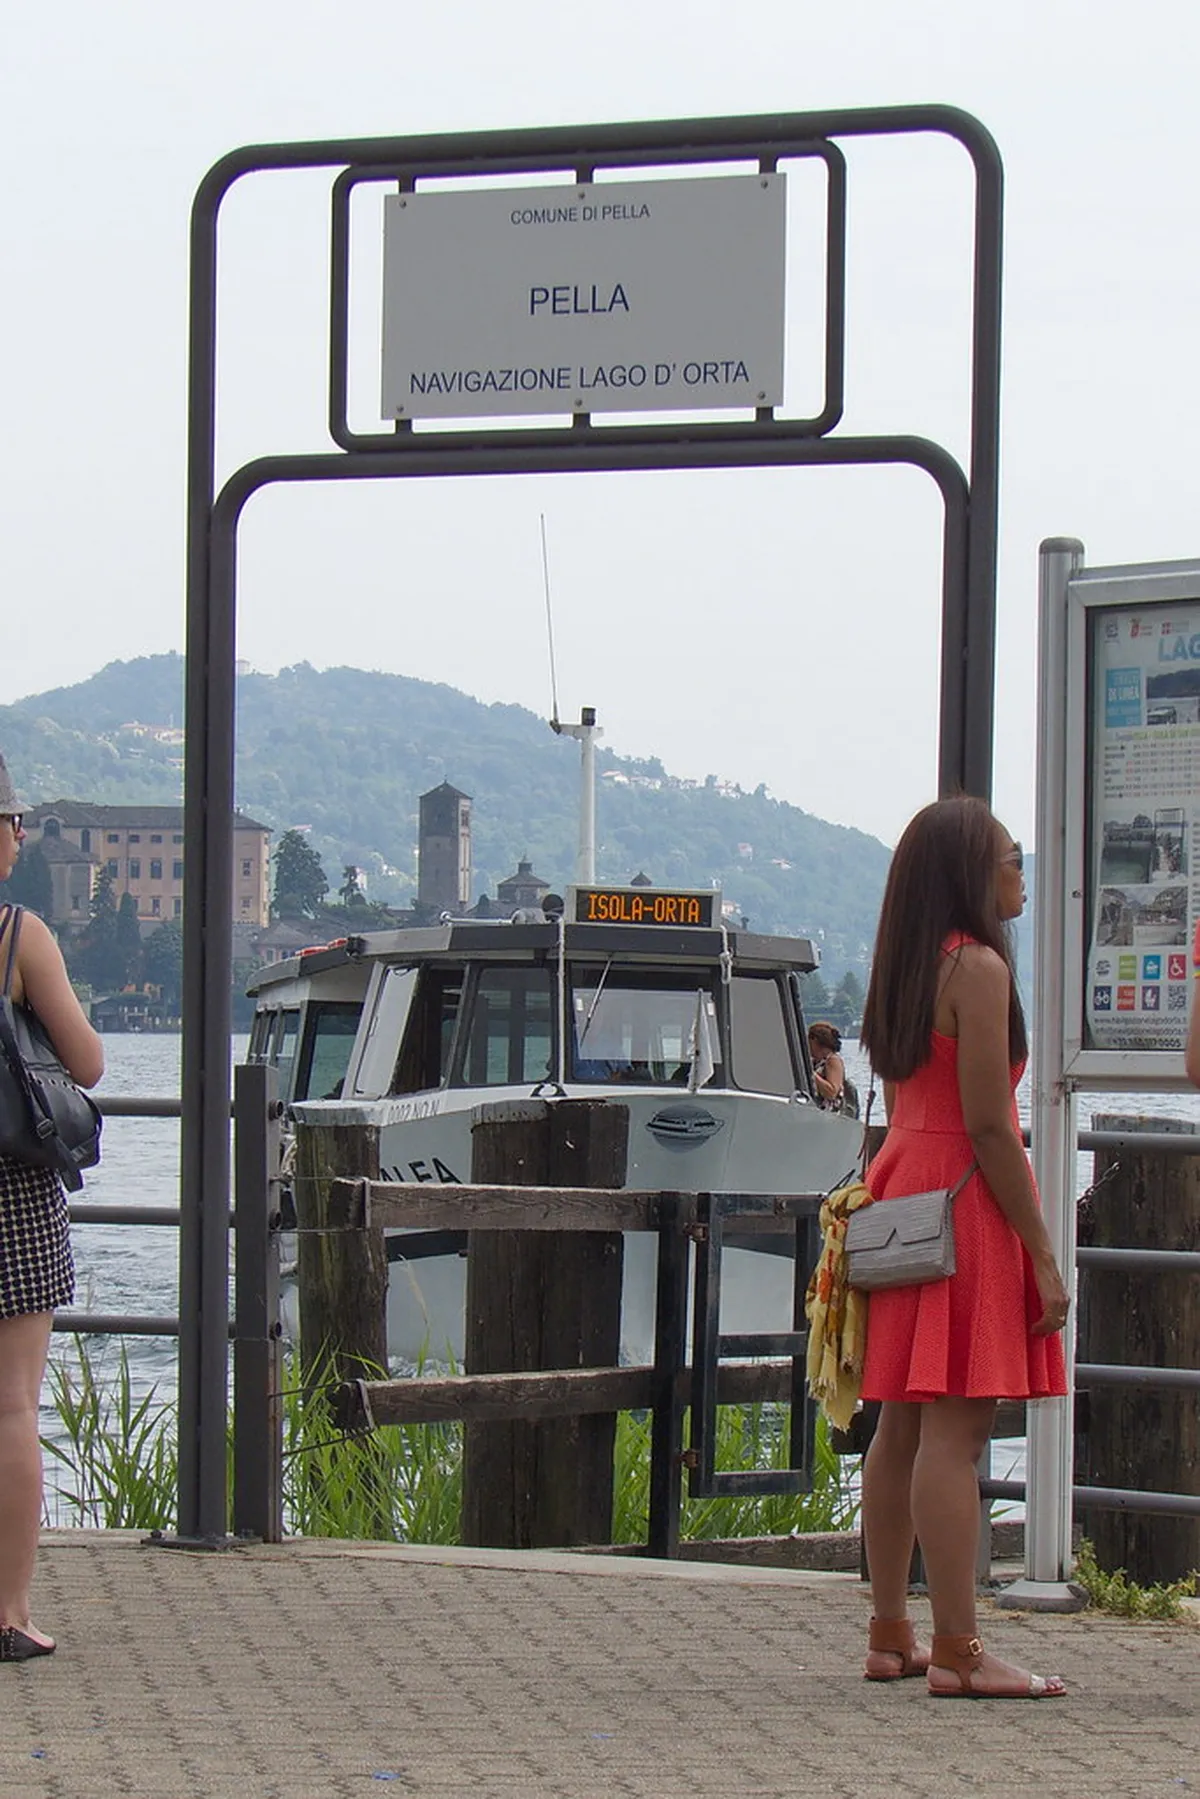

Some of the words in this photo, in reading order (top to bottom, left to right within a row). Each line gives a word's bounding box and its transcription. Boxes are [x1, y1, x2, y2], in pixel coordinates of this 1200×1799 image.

[510, 207, 577, 225] COMUNE
[582, 206, 597, 221] DI
[602, 204, 650, 220] PELLA
[530, 283, 629, 315] PELLA
[410, 367, 571, 394] NAVIGAZIONE
[579, 364, 647, 388] LAGO
[654, 363, 677, 386] D'
[683, 361, 749, 385] ORTA
[588, 893, 700, 923] ISOLA-ORTA
